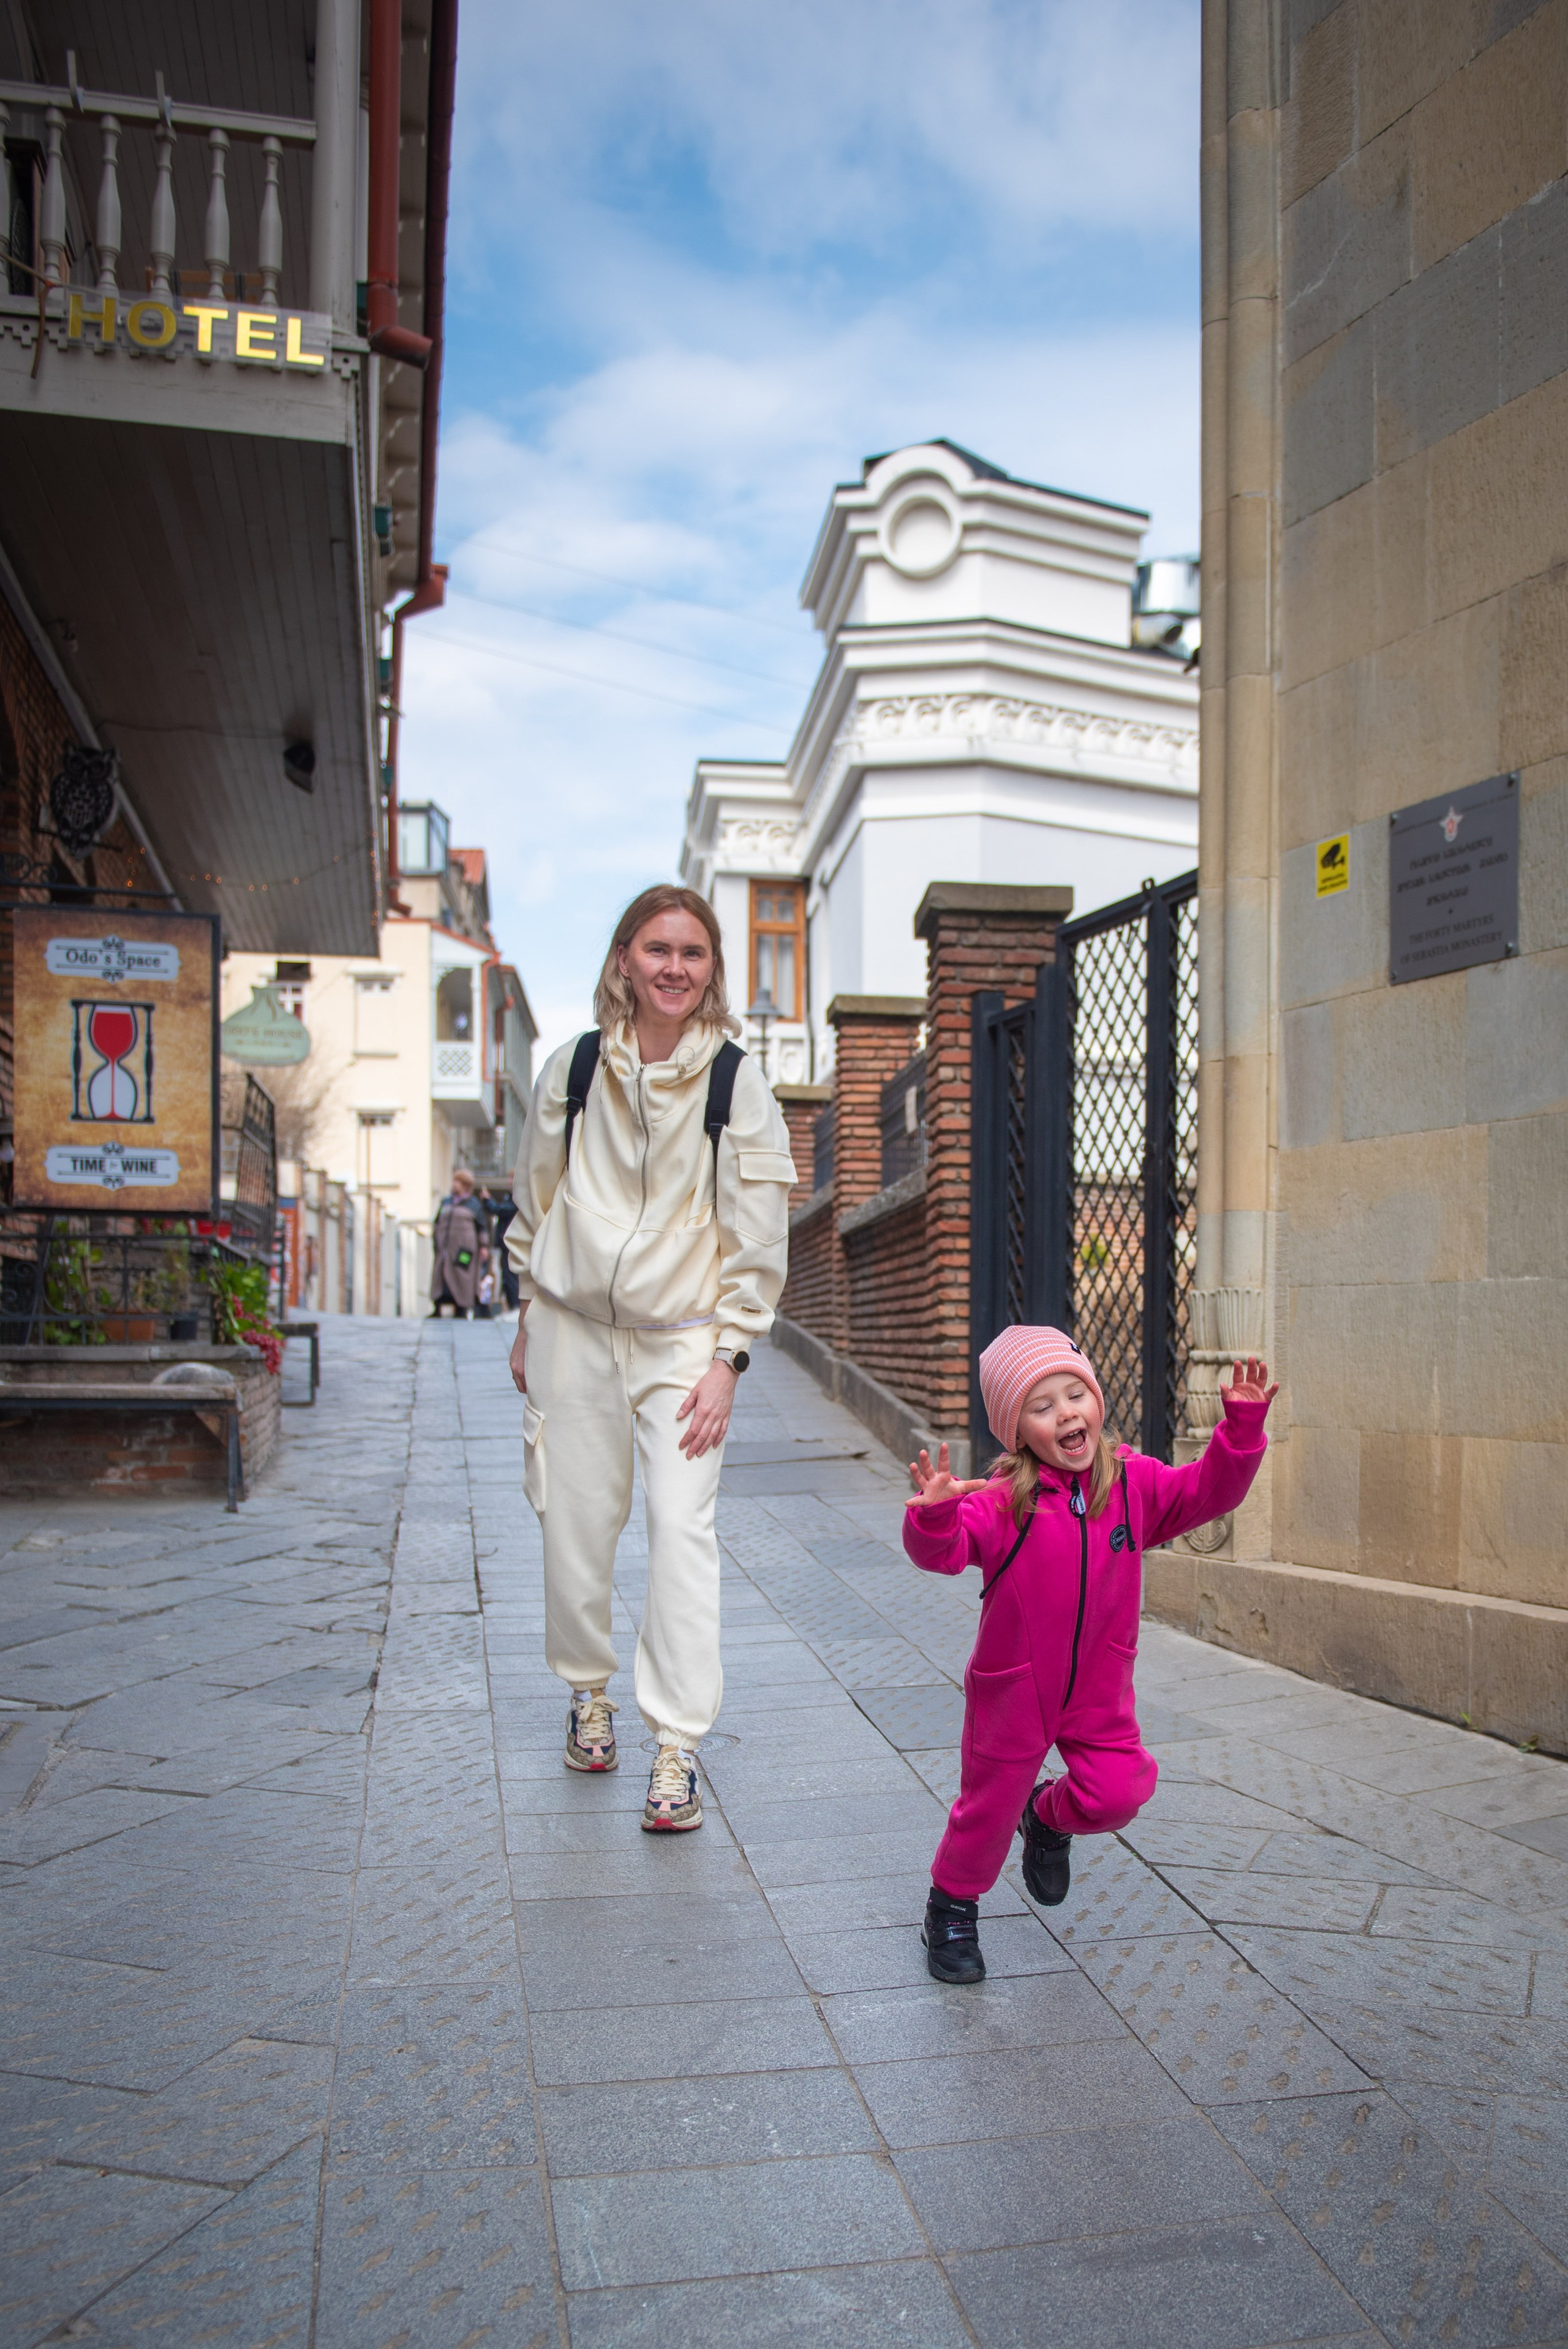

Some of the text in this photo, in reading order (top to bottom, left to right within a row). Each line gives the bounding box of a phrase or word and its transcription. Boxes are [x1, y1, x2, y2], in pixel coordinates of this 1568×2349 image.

[67, 293, 325, 366] HOTEL
[1425, 924, 1451, 941] FORTY
[1452, 913, 1494, 933] MARTYRS
[1450, 930, 1504, 952] MONASTERY
[116, 951, 161, 970] Space
[71, 1156, 106, 1174] TIME
[120, 1158, 157, 1174] WINE
